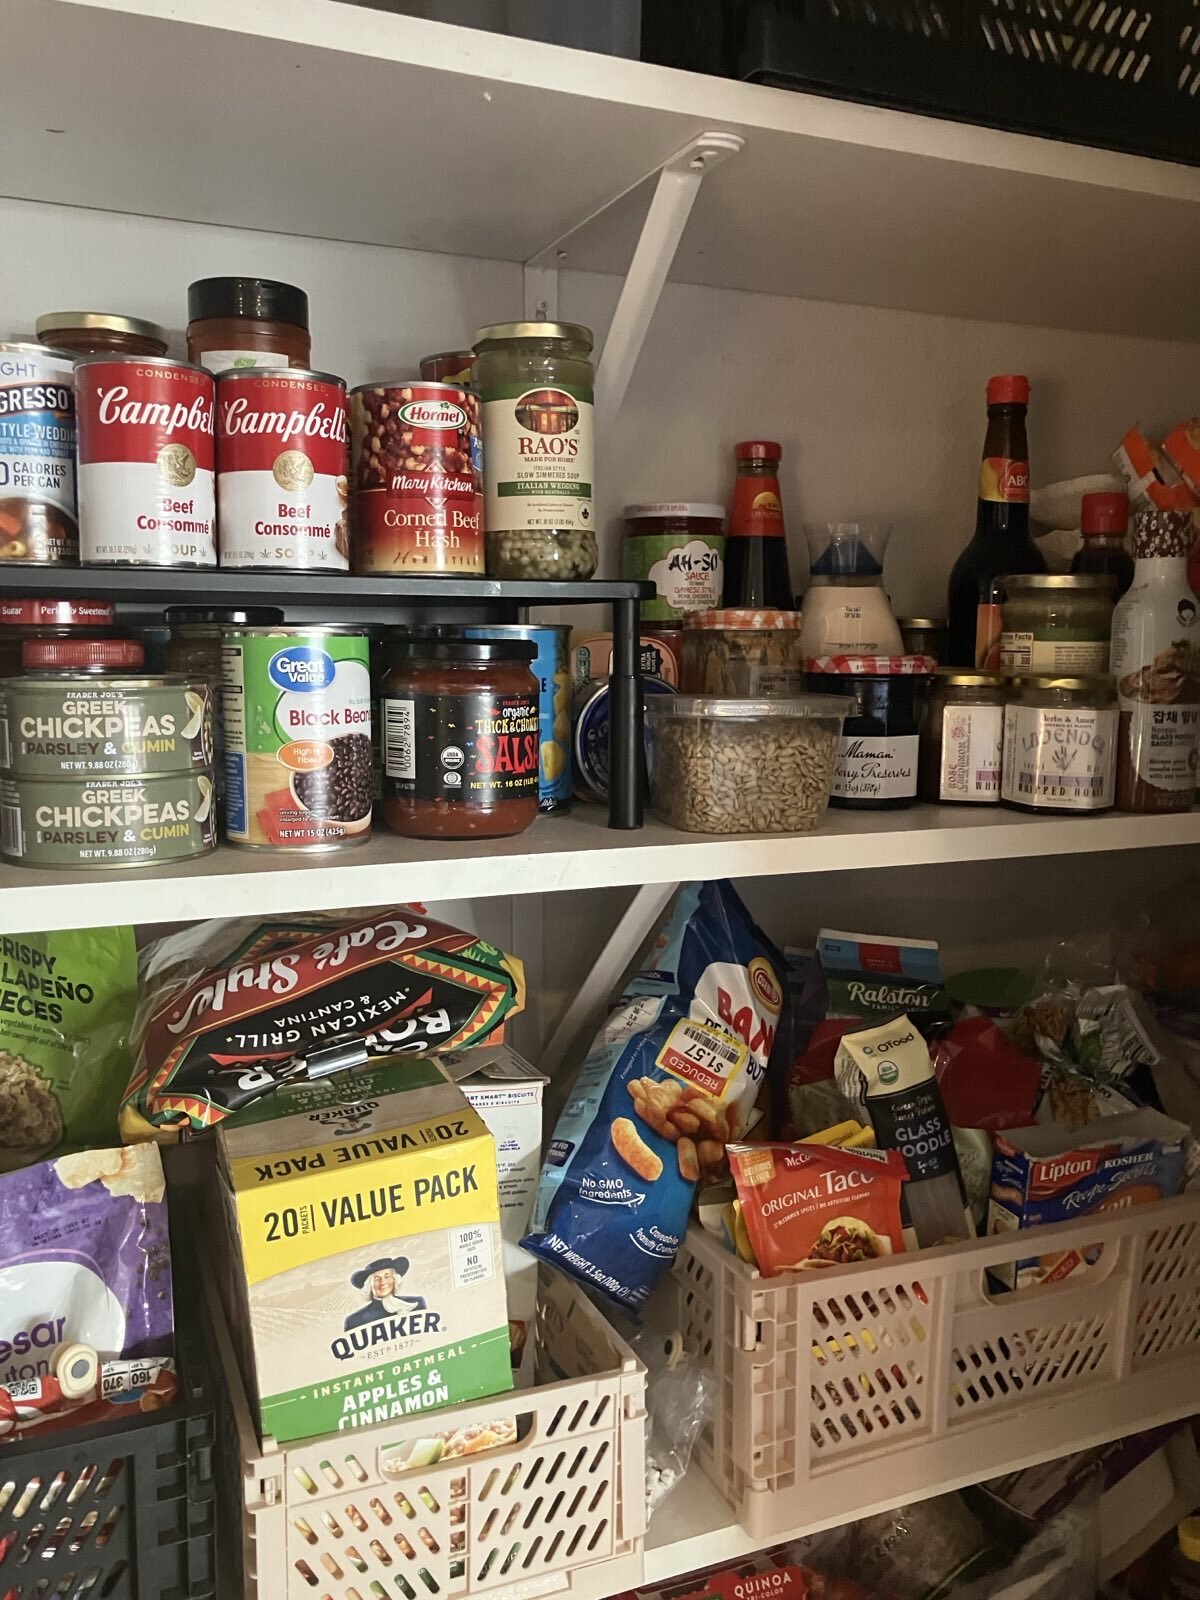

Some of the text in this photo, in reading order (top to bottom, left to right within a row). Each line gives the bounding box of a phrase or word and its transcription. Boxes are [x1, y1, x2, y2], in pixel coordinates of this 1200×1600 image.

[255, 380, 327, 393] CONDENSED
[410, 404, 460, 423] Hormel
[518, 437, 579, 456] RAO'S
[13, 461, 67, 477] CALORIES
[517, 471, 580, 480] SLOW SIMMERED SOUP
[13, 474, 61, 489] PER CAN
[392, 475, 474, 494] Mary Kitchen
[517, 482, 580, 491] ITALIAN WEDDING
[1007, 474, 1028, 486] ABC
[163, 498, 194, 515] Beef
[278, 503, 311, 519] Beef
[384, 509, 481, 530] Corned Beef
[415, 530, 460, 548] Hash
[668, 553, 718, 572] AH-SO
[684, 572, 710, 580] SAUCE
[2, 607, 22, 616] Sugar
[276, 656, 324, 673] Great
[288, 672, 325, 685] Value
[66, 691, 125, 699] TRADER JOE'S
[62, 700, 127, 715] GREEK
[502, 706, 530, 720] organic
[289, 709, 339, 726] Black
[475, 717, 509, 734] THICK
[1153, 710, 1178, 724] 잡채
[20, 715, 175, 739] CHICKPEAS
[28, 739, 176, 756] PARSLEY & CUMIN
[293, 747, 312, 758] High
[840, 739, 894, 759] Maman
[61, 761, 73, 770] NET
[75, 761, 87, 770] WT.
[87, 761, 104, 770] 9.88
[104, 761, 114, 769] OZ
[860, 762, 912, 780] Preserves
[82, 789, 146, 805] GREEK
[35, 800, 189, 828] CHICKPEAS
[44, 824, 189, 844] PARSLEY & CUMIN
[280, 826, 346, 838] NET WT 15 OZ (425g)
[80, 846, 157, 858] NET WT. 9.88 OZ (280g)
[0, 936, 56, 975] RISPY
[168, 920, 428, 1034] Café Style
[847, 981, 931, 1007] Ralston
[234, 989, 406, 1048] MEXICAN GRILL
[273, 995, 371, 1029] & CANTINA
[684, 1043, 724, 1073] $1.57
[669, 1055, 720, 1090] REDUCED
[507, 1091, 534, 1099] BISCUITS
[309, 1101, 380, 1121] QUAKER
[895, 1116, 941, 1141] GLASS
[254, 1120, 469, 1182] 20 VALUE PACK
[896, 1129, 951, 1158] OODLE
[1105, 1152, 1154, 1169] KOSHER
[1039, 1159, 1091, 1182] Lipton
[582, 1177, 624, 1189] No GMO
[578, 1187, 632, 1200] Ingredients
[761, 1185, 822, 1217] ORIGINAL
[264, 1207, 299, 1242] 20
[320, 1183, 405, 1228] VALUE
[414, 1164, 479, 1207] PACK
[459, 1229, 482, 1243] 100%
[467, 1255, 478, 1266] NO
[549, 1234, 568, 1254] NET
[565, 1244, 592, 1274] WEIGHT
[330, 1311, 442, 1361] QUAKER
[393, 1338, 416, 1352] 1877
[103, 1370, 151, 1392] 160 370
[313, 1345, 467, 1400] INSTANT OATMEAL
[342, 1369, 443, 1414] APPLES &
[338, 1384, 450, 1430] CINNAMON
[734, 1571, 793, 1599] QUINOA
